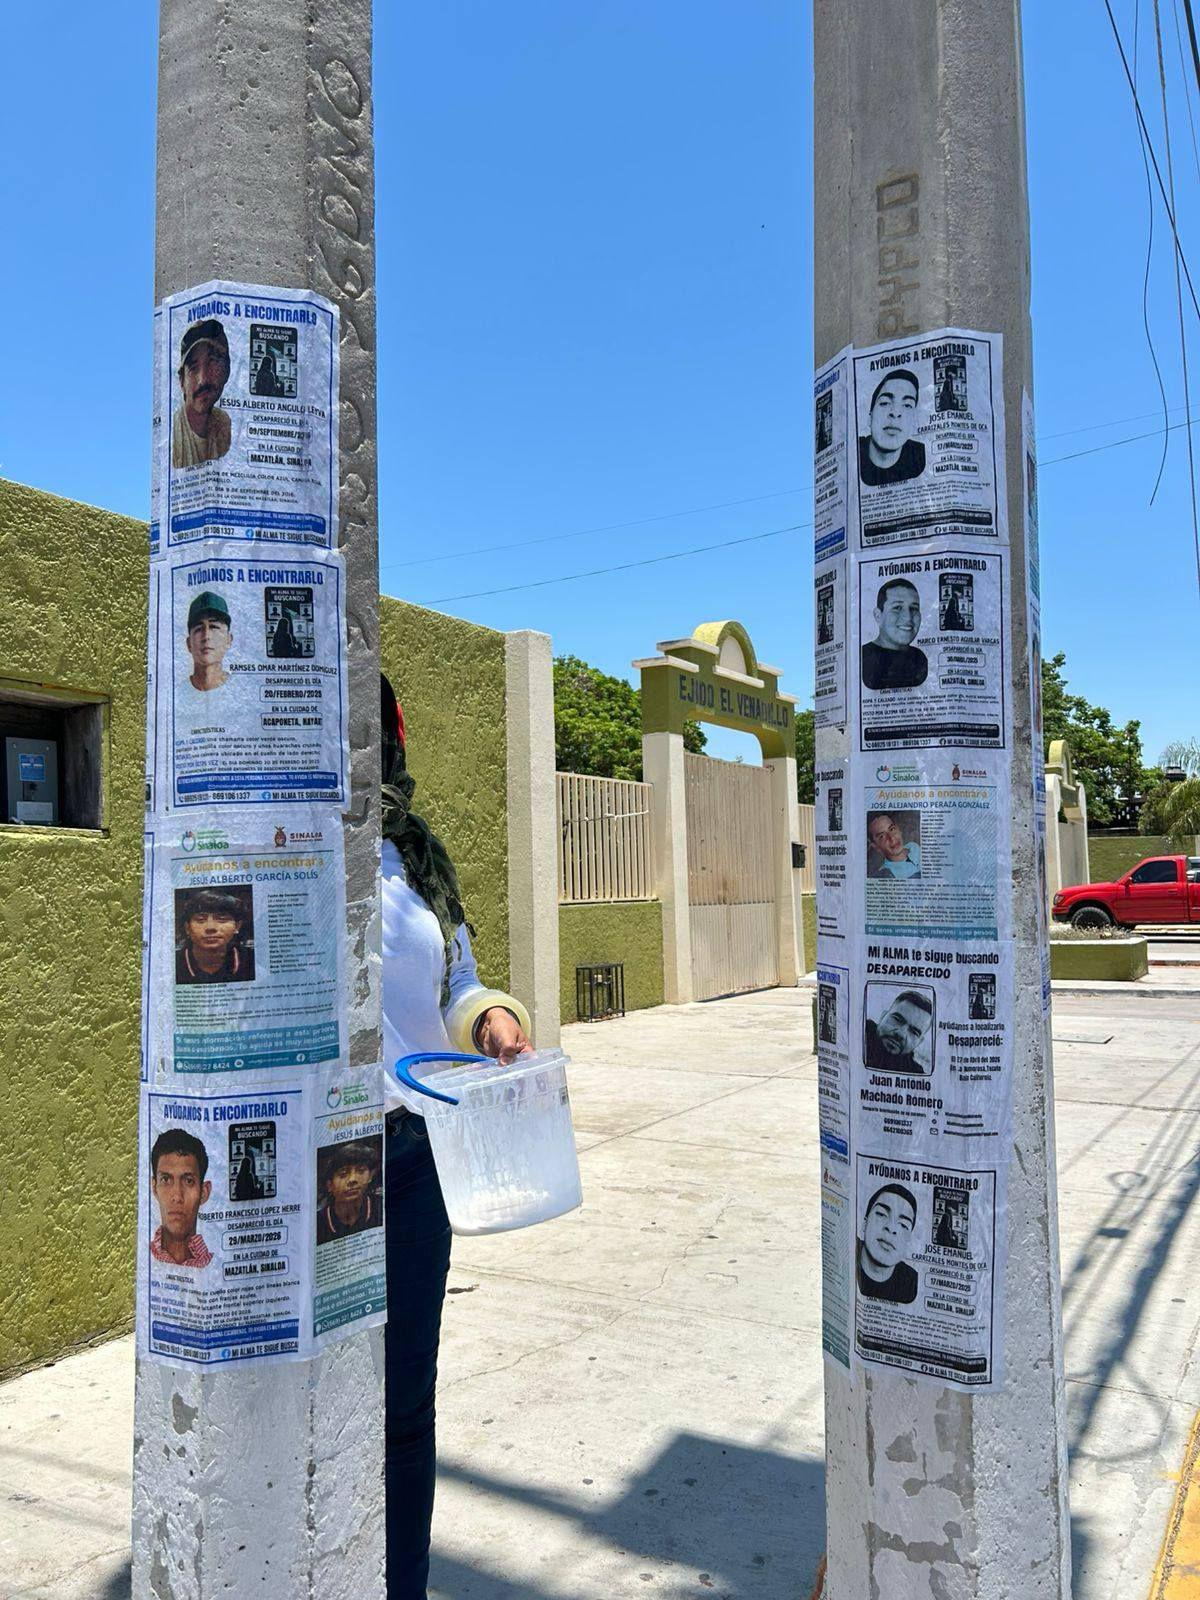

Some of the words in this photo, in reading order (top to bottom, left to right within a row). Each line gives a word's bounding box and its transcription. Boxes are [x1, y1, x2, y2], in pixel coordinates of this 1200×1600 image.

[234, 304, 241, 317] A
[244, 304, 317, 326] ENCONTRARLO
[259, 333, 289, 341] BUSCANDO
[870, 352, 911, 372] AYÚDANOS
[913, 351, 919, 362] A
[921, 343, 974, 360] ENCONTRARLO
[242, 400, 275, 410] ALBERTO
[277, 403, 306, 414] ANGULO
[929, 413, 945, 424] JOSE
[947, 411, 974, 420] EMANUEL
[262, 531, 278, 539] ALMA
[878, 560, 922, 577] AYÚDANOS
[924, 561, 930, 572] A
[933, 558, 987, 572] ENCONTRARLO
[237, 570, 244, 582] A
[248, 569, 324, 585] ENCONTRARLO
[274, 594, 305, 602] BUSCANDO
[230, 664, 256, 672] RAMSES
[258, 664, 276, 672] OMAR
[278, 663, 310, 672] MARTÍNEZ
[679, 674, 714, 708] EJIDO
[720, 688, 734, 713] EL
[737, 692, 788, 728] VENADILLO
[893, 773, 919, 782] Sinaloa
[928, 790, 934, 798] a
[243, 861, 250, 870] a
[210, 873, 252, 884] ALBERTO
[255, 870, 291, 882] GARCÍA
[294, 870, 319, 880] SOLÍS
[868, 946, 880, 958] Mi
[883, 947, 909, 960] ALMA
[912, 950, 921, 960] te
[924, 950, 953, 963] sigue
[956, 952, 999, 964] buscando
[867, 963, 951, 979] DESAPARECIDO
[948, 1034, 1003, 1048] Desapareció:
[870, 1074, 892, 1087] Juan
[894, 1077, 931, 1091] Antonio
[860, 1089, 903, 1104] Machado
[906, 1094, 943, 1109] Romero
[164, 1102, 202, 1121] AYÚDANOS
[204, 1108, 210, 1122] A
[213, 1102, 287, 1121] ENCONTRARLO
[238, 1130, 267, 1139] BUSCANDO
[355, 1124, 383, 1136] ALBERTO
[868, 1163, 911, 1181] AYÚDANOS
[913, 1170, 919, 1182] A
[922, 1172, 979, 1190] ENCONTRARLO
[225, 1208, 259, 1218] FRANCISCO
[261, 1206, 279, 1215] LOPEZ
[925, 1244, 941, 1254] JOSE
[943, 1247, 973, 1260] EMANUEL
[261, 1261, 286, 1272] SINALOA
[912, 1253, 945, 1265] CARRIZALES
[946, 1259, 968, 1269] MONTES
[240, 1346, 255, 1355] ALMA
[264, 1343, 279, 1352] SIGUE
